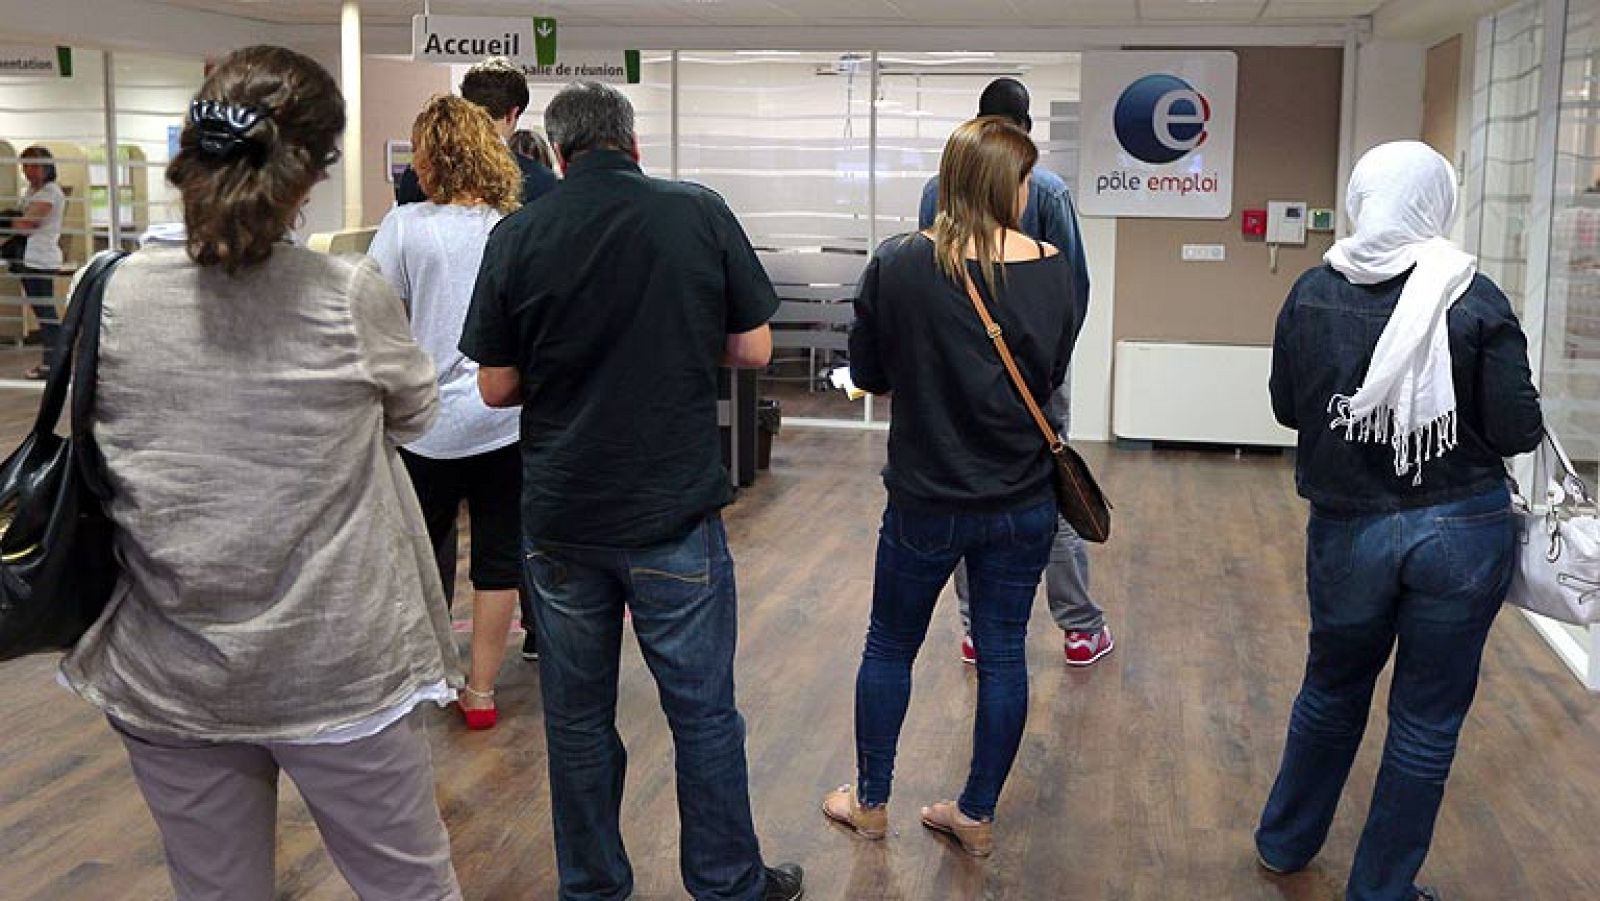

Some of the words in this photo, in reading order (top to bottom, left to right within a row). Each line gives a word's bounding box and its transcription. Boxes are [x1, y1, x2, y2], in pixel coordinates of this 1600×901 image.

[424, 32, 520, 55] Accueil
[555, 62, 572, 76] de
[574, 62, 624, 76] réunion
[1096, 170, 1141, 195] pôle
[1147, 171, 1218, 196] emploi
